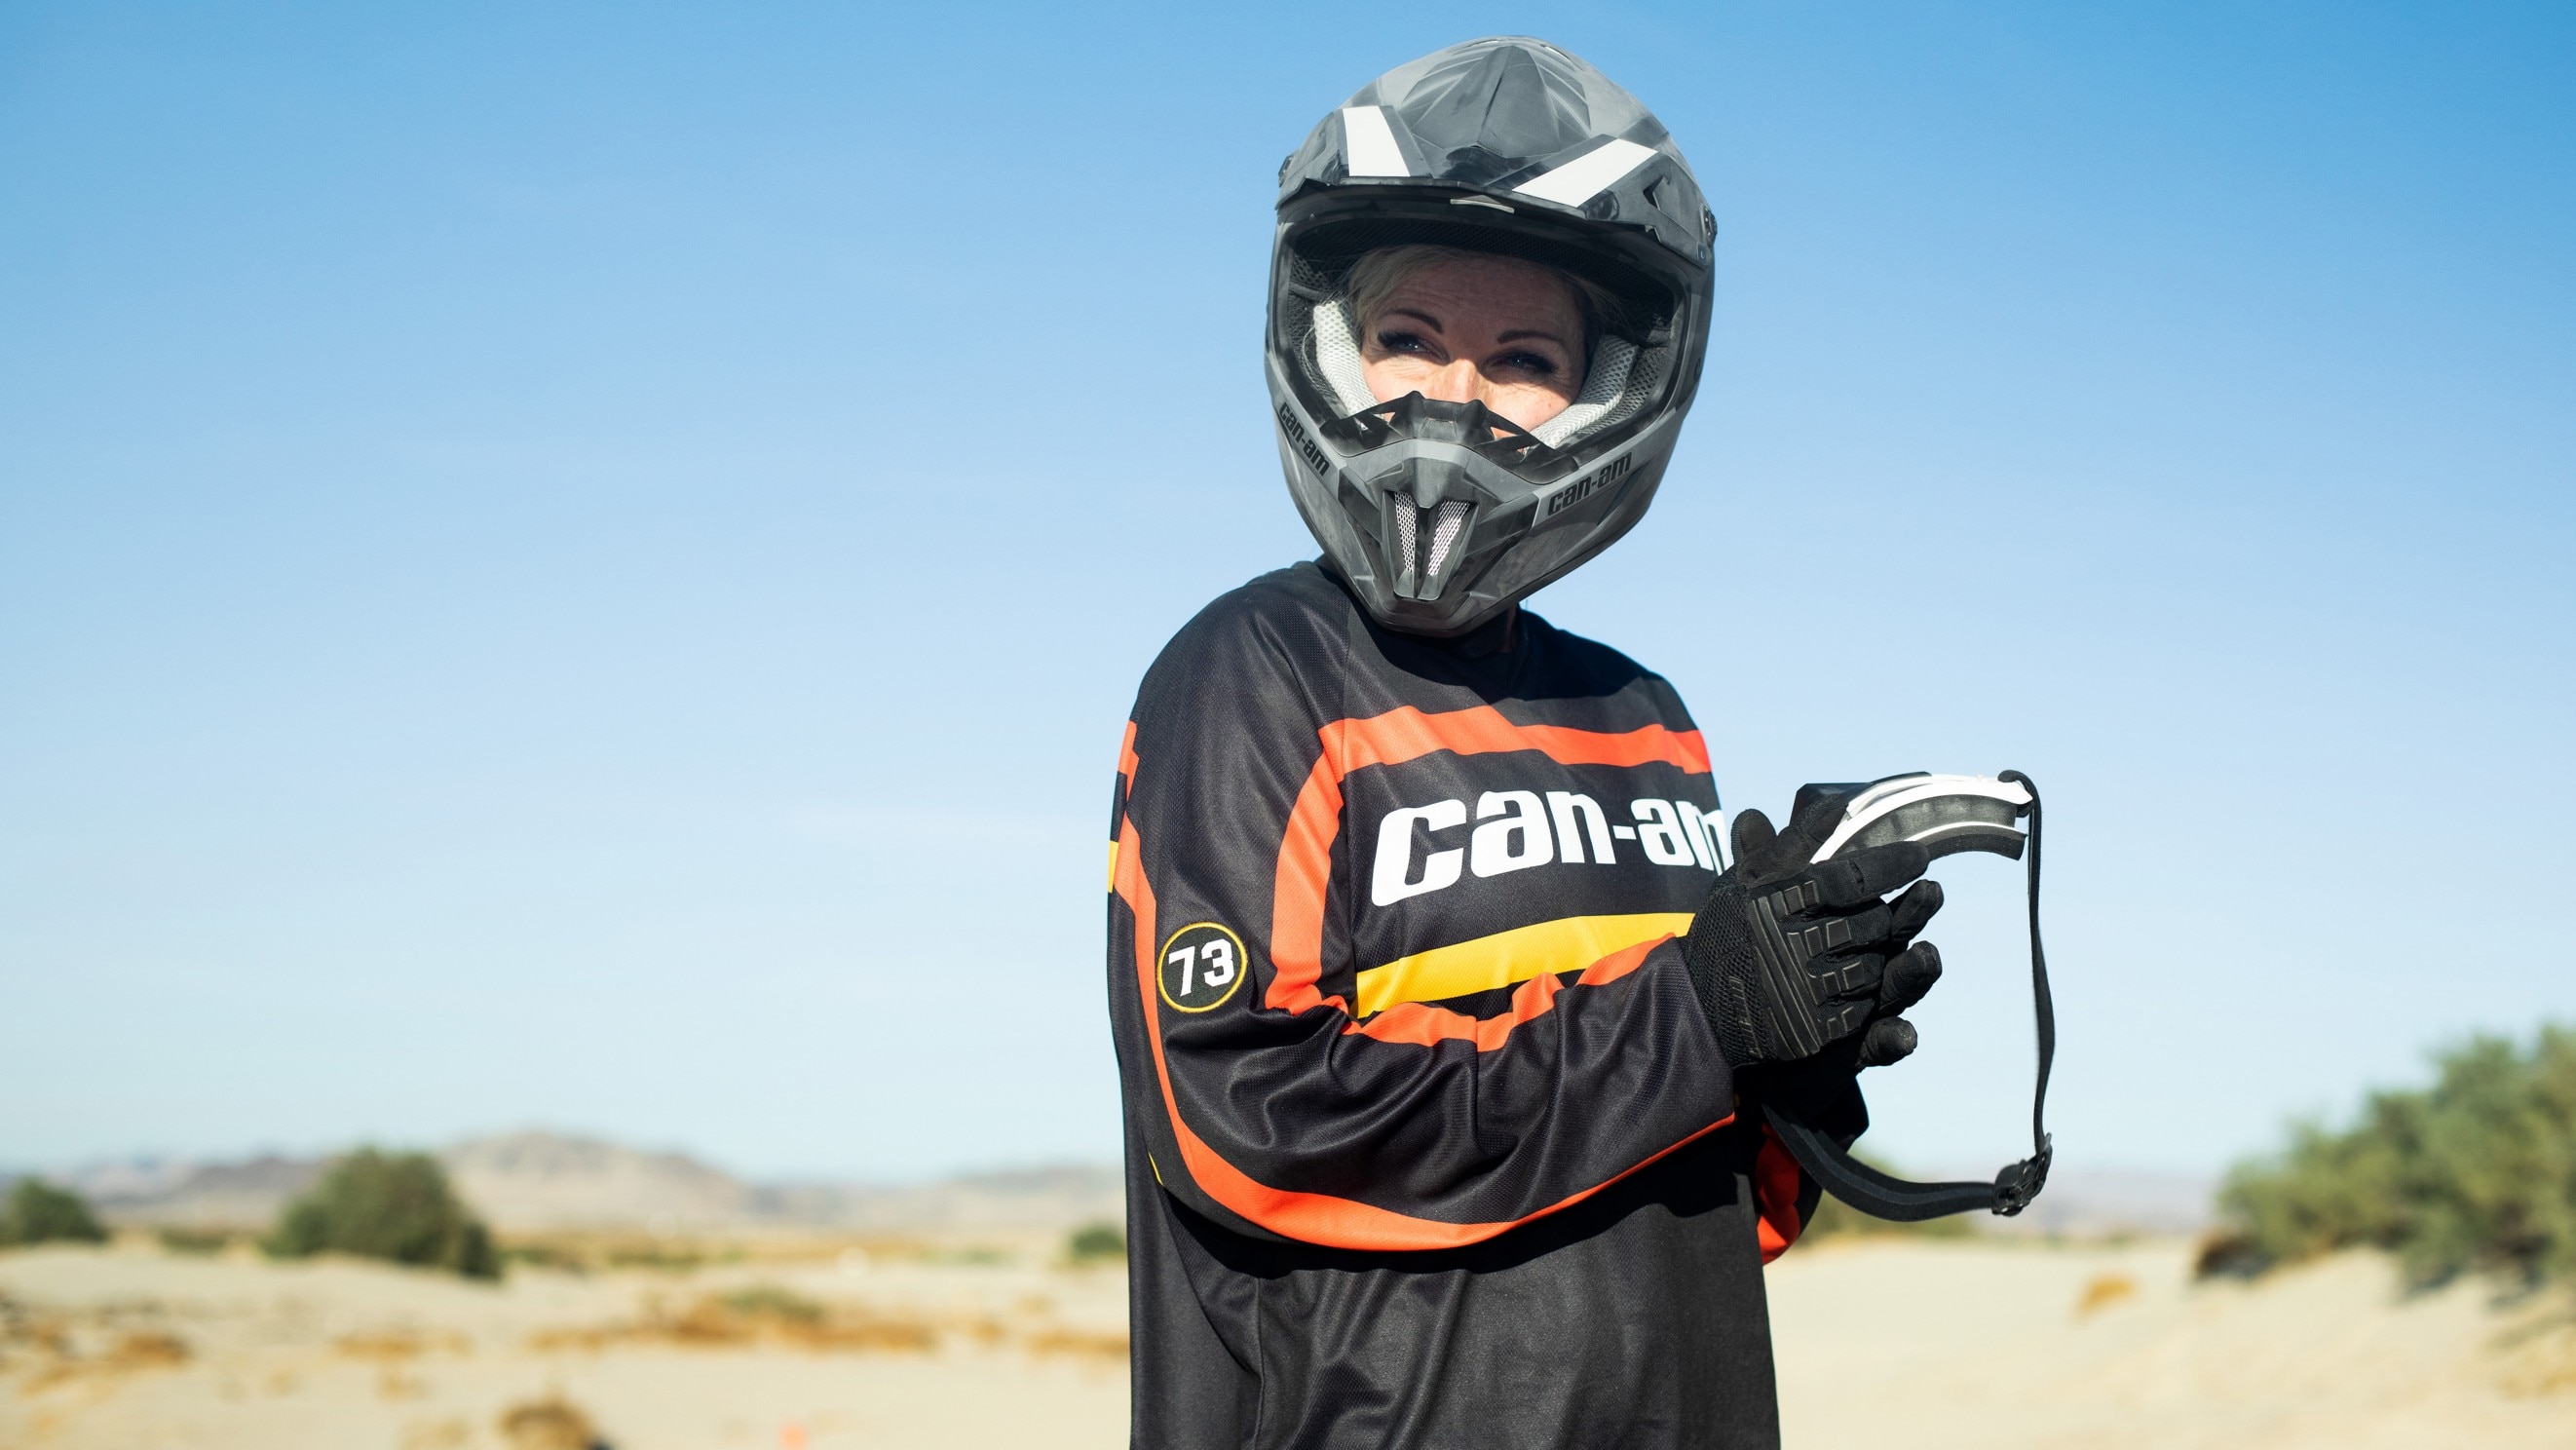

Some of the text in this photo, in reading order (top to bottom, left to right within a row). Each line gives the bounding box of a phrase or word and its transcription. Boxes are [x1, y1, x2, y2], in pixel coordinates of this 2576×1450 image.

[1279, 401, 1330, 477] can-am
[1548, 451, 1632, 515] can-am
[1371, 790, 1734, 907] can-am
[1168, 938, 1234, 997] 73
